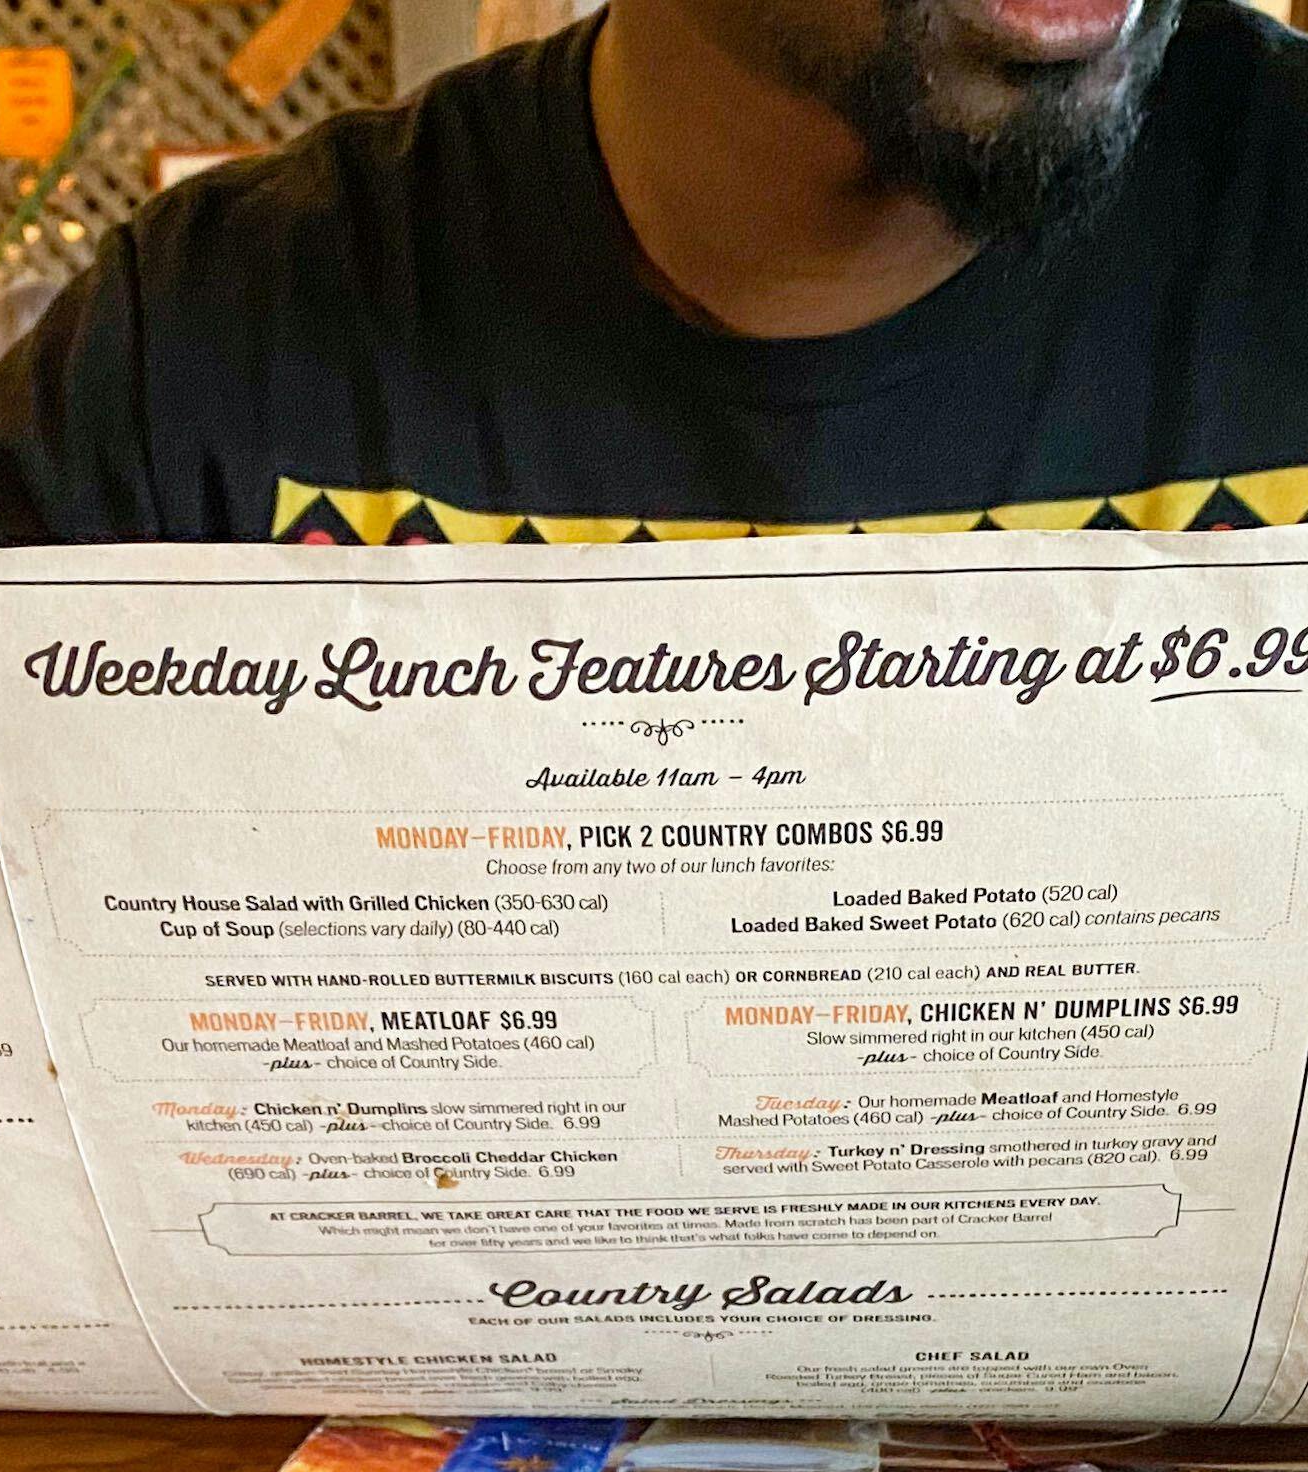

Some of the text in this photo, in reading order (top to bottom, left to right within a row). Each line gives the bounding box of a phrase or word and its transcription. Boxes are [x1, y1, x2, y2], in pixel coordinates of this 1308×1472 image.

[24, 640, 308, 715] Weekday
[314, 637, 516, 712] Lunch
[528, 637, 796, 701] Features
[803, 630, 1067, 706] Starting
[1074, 632, 1145, 687] at
[525, 766, 807, 789] Available 11am 4pm
[580, 826, 635, 850] PICK
[641, 826, 654, 848] 2
[661, 824, 768, 848] COUNTRY
[776, 821, 873, 846] COMBOS
[881, 820, 944, 844] $6.99
[103, 894, 489, 914] Country House Salad with Grilled Chicken
[832, 887, 1036, 908] Loaded Baked Potato
[160, 920, 274, 940] Cup of Soup
[731, 907, 1220, 934] Loaded Baked Sweet Potato contains pecans
[435, 963, 1139, 986] BUTTERMILK BISCUITS CORNBREAD BUTTER.
[920, 1002, 1015, 1023] CHICKEN
[1055, 998, 1170, 1019] DUMPLINS
[1178, 995, 1239, 1017] $6.99
[381, 1011, 557, 1031] MEATLOAF $6.99
[253, 1102, 427, 1115] Chicken Dumplins
[402, 1150, 617, 1163] Broccoli Cheddar Chicken
[828, 1143, 984, 1160] Turkey Dressing
[489, 1276, 912, 1311] Country Salads
[916, 1351, 1029, 1362] CHEF SALAD
